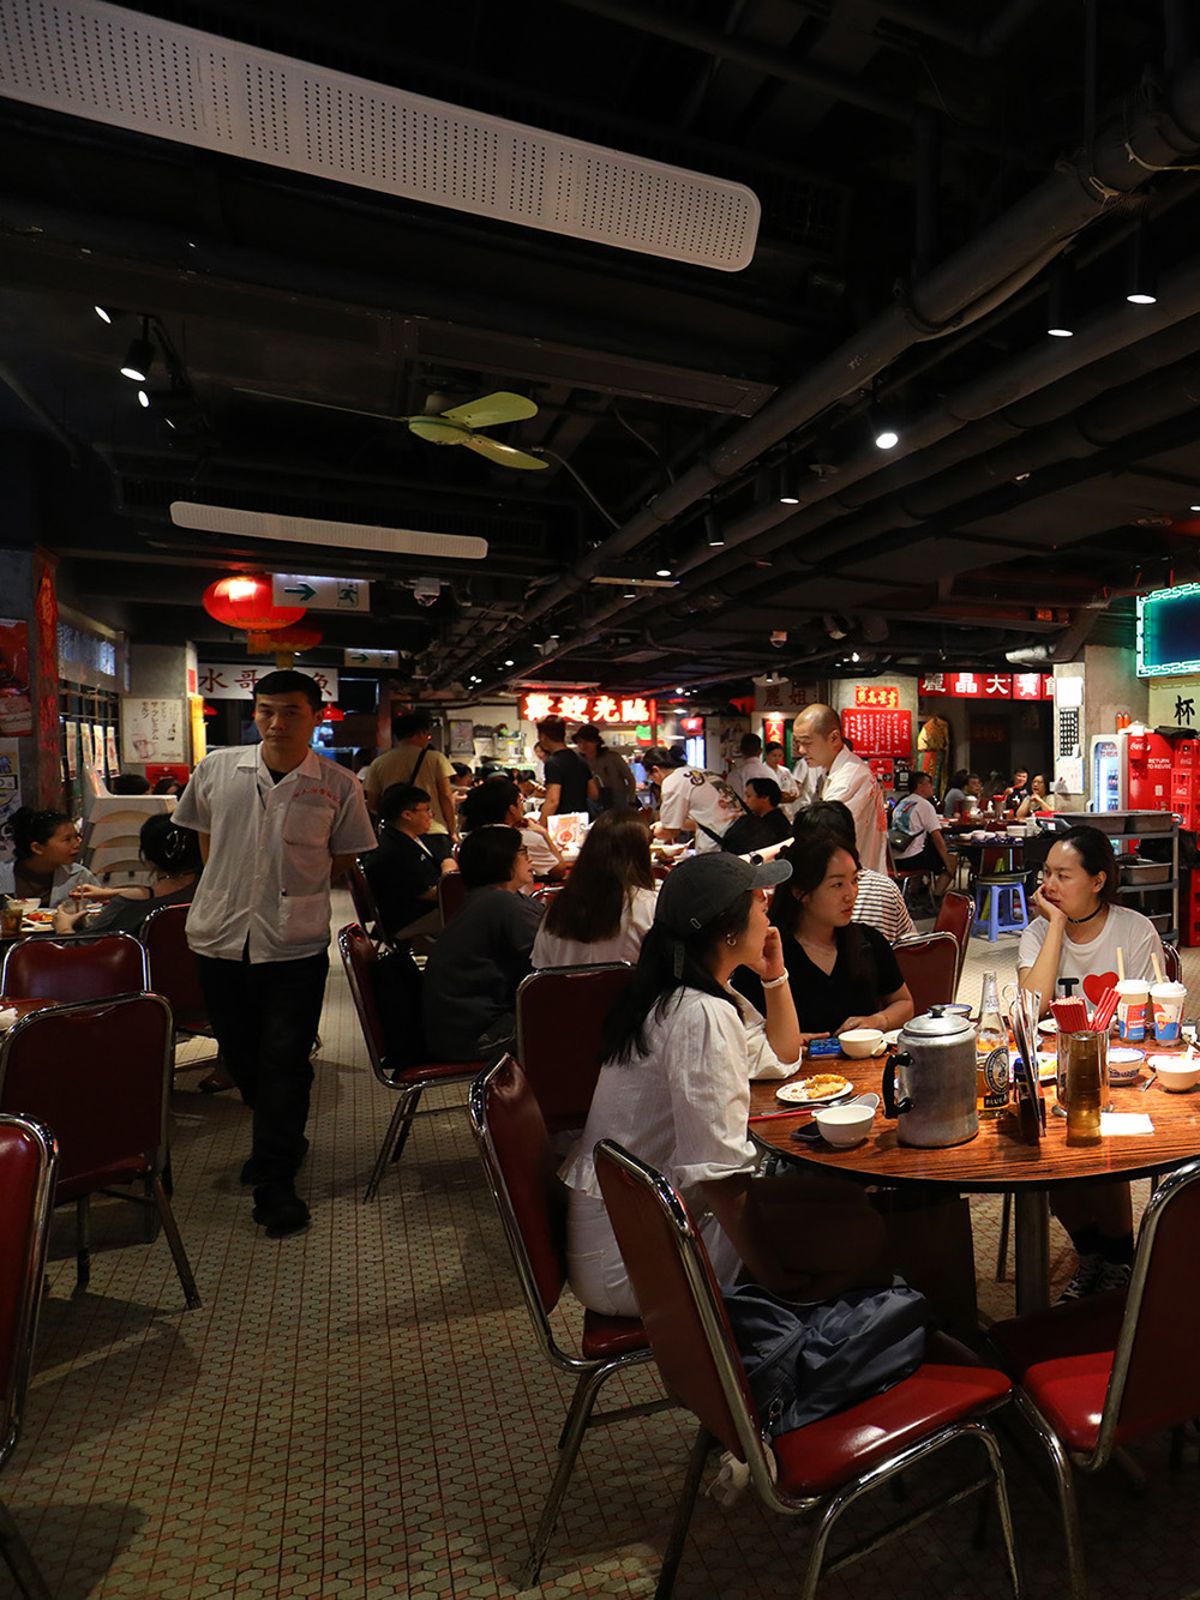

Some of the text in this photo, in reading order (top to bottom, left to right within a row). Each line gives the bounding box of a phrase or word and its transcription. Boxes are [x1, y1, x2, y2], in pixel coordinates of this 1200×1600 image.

[199, 668, 333, 698] 水哥魚
[1174, 695, 1196, 726] 杯
